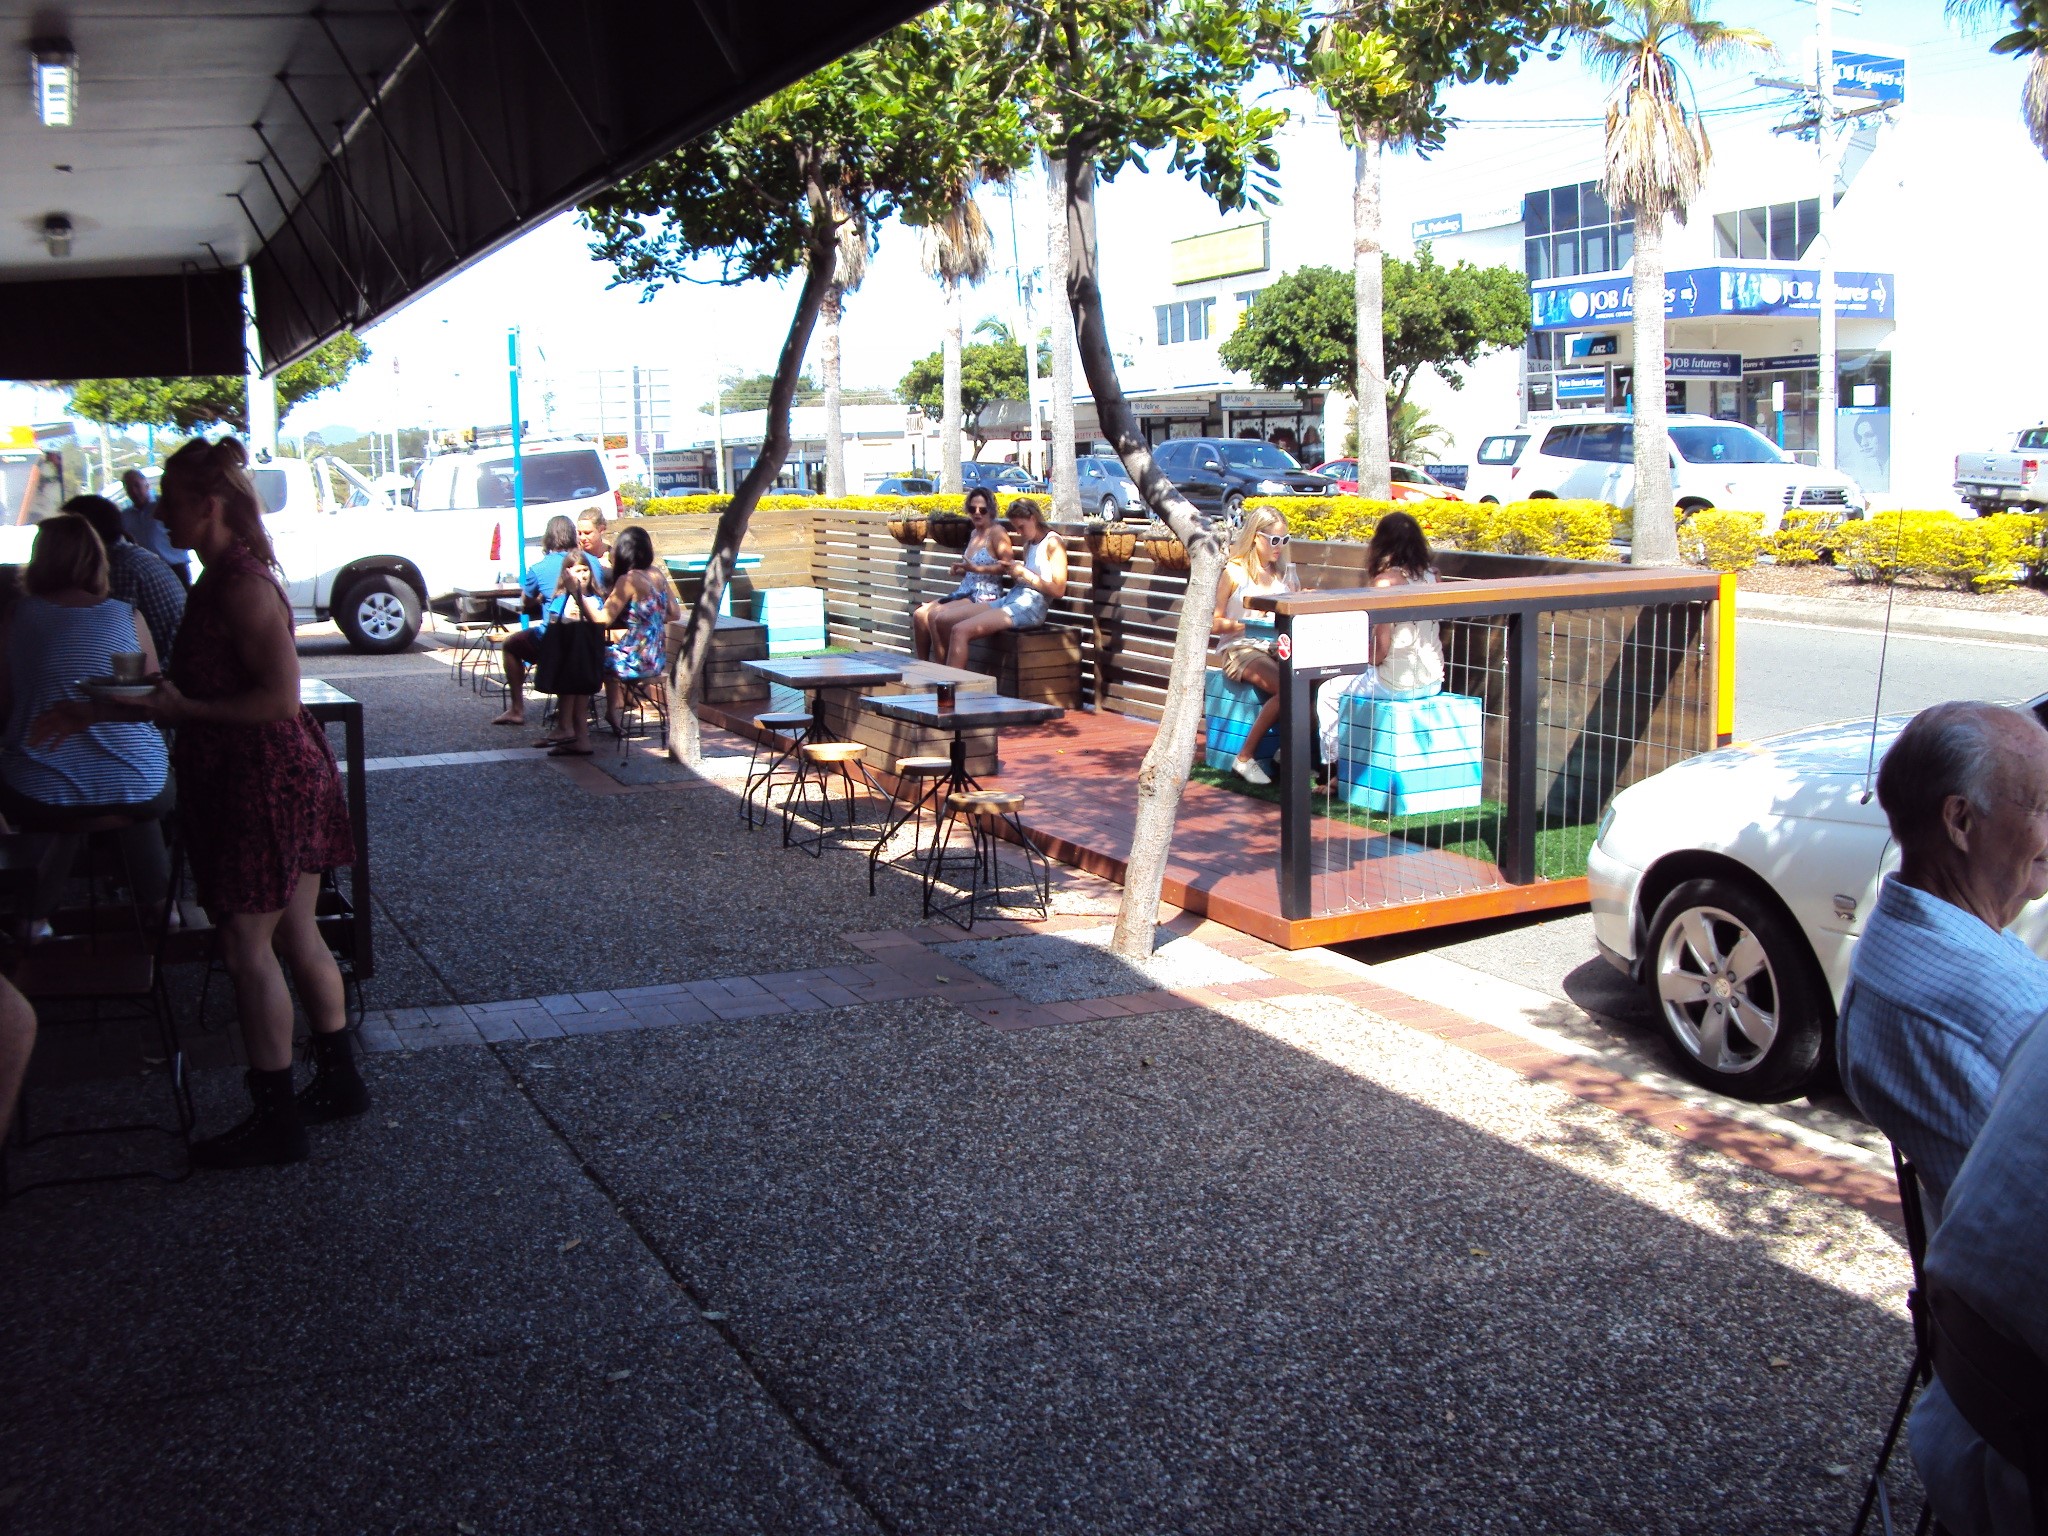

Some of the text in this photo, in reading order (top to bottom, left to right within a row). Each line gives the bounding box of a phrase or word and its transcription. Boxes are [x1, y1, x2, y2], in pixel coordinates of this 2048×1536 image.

[1782, 281, 1869, 304] JOB ftures
[1590, 287, 1676, 317] JOB fues
[1592, 345, 1606, 354] ANZ
[1672, 357, 1721, 370] JOB futures
[1620, 376, 1630, 397] 7
[682, 454, 698, 462] PARK
[655, 473, 698, 484] Fresh Meats
